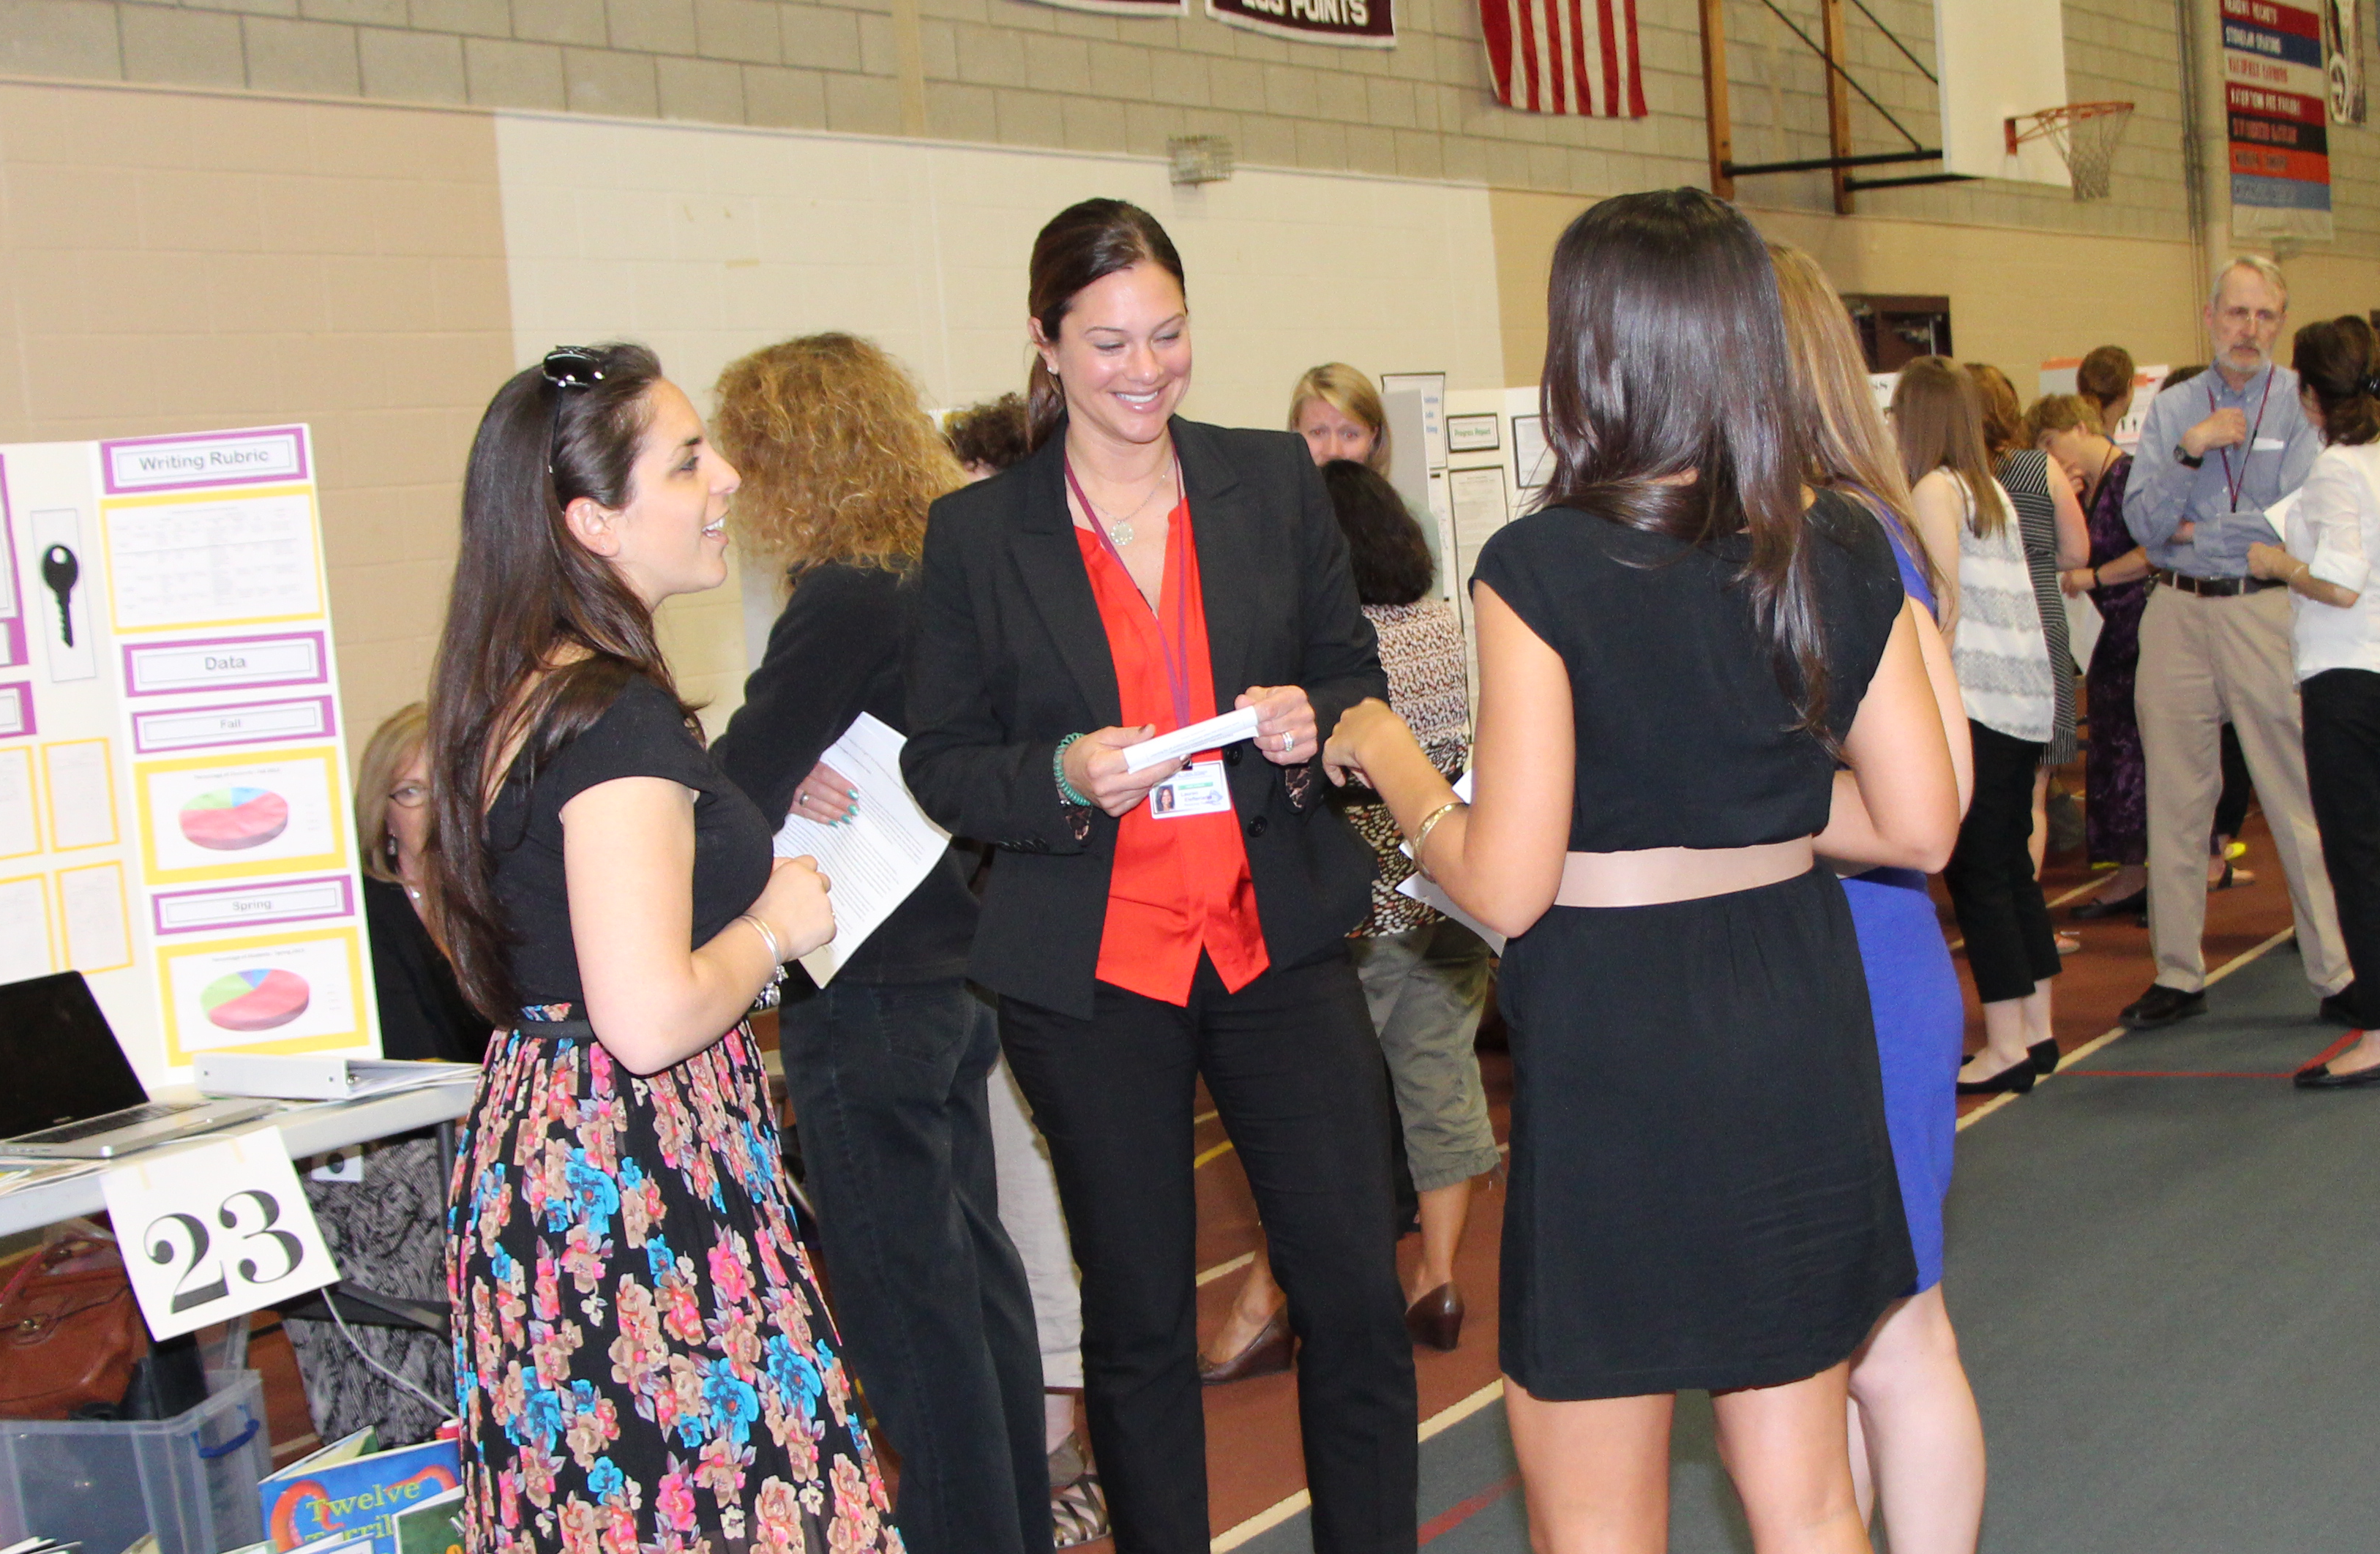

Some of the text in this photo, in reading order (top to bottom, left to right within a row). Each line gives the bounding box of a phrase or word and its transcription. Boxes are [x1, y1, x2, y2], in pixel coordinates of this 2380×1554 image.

[139, 448, 269, 470] Writing Rubric
[204, 656, 245, 670] Data
[220, 718, 241, 729] Fall
[232, 899, 272, 912] Spring
[143, 1190, 304, 1314] 23
[305, 1482, 421, 1523] Twelve
